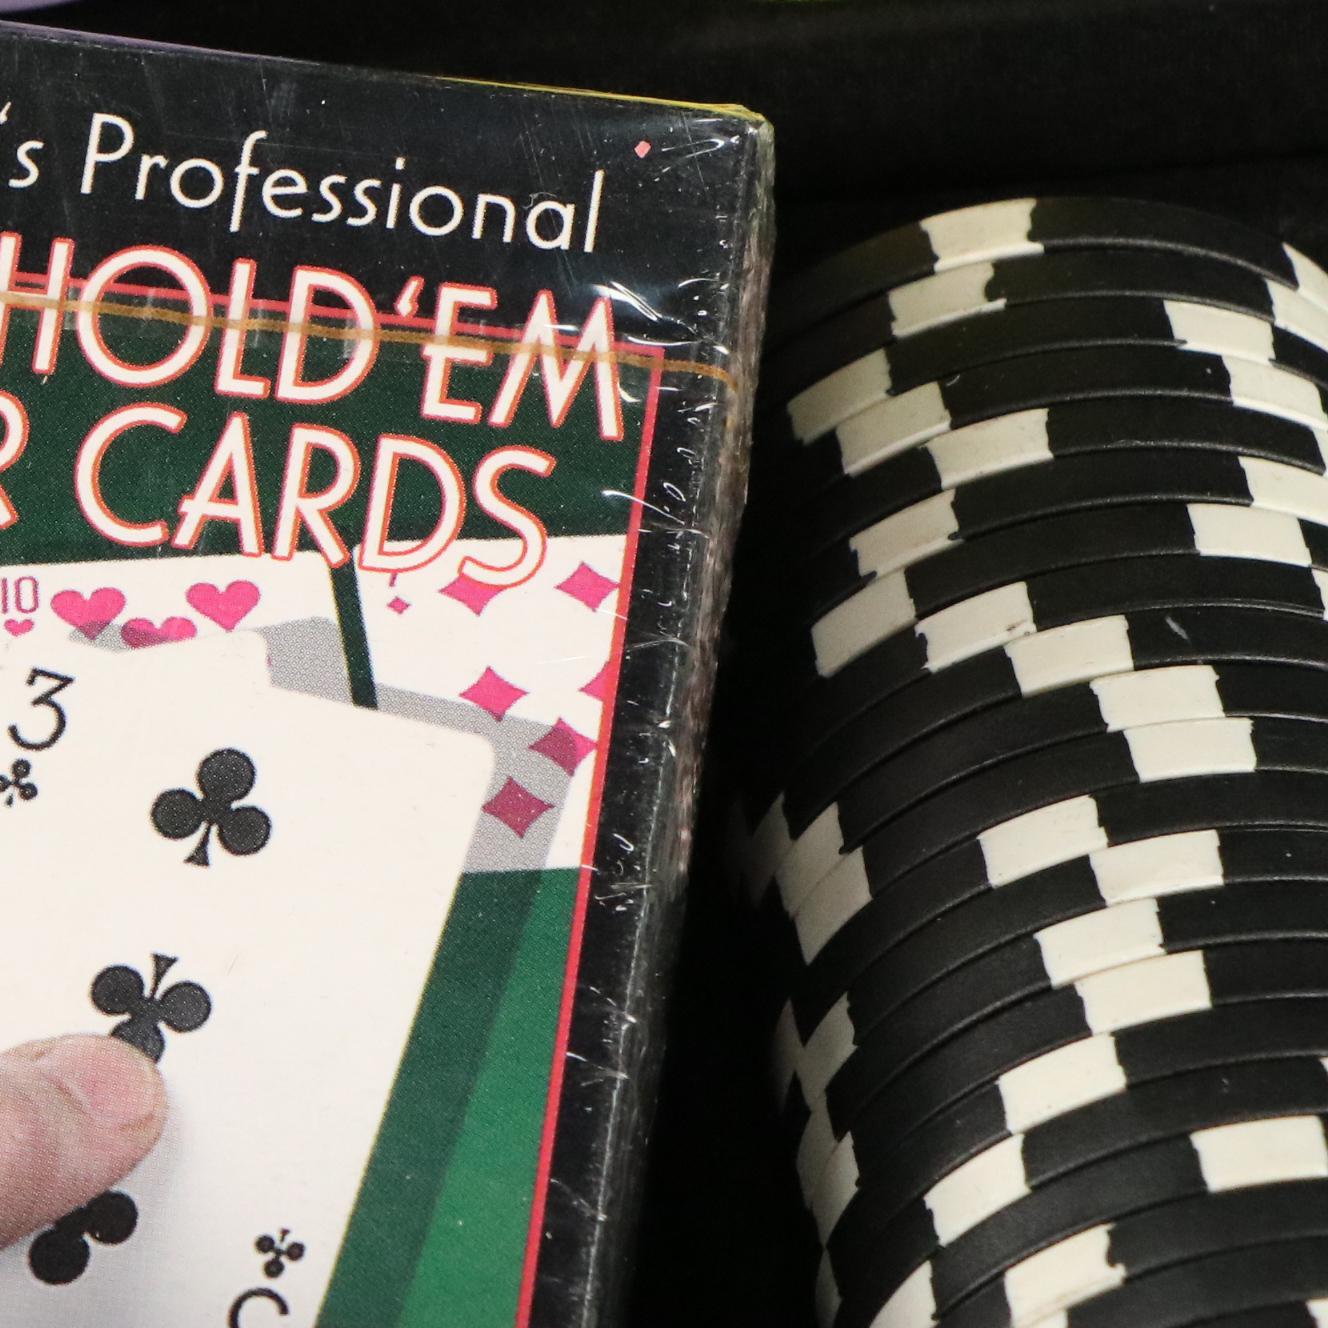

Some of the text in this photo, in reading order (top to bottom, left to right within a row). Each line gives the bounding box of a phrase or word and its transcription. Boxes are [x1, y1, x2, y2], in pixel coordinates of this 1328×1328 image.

[79, 112, 604, 253] Professional
[74, 402, 556, 586] CARDS
[0, 574, 41, 616] 10
[7, 667, 75, 752] 3
